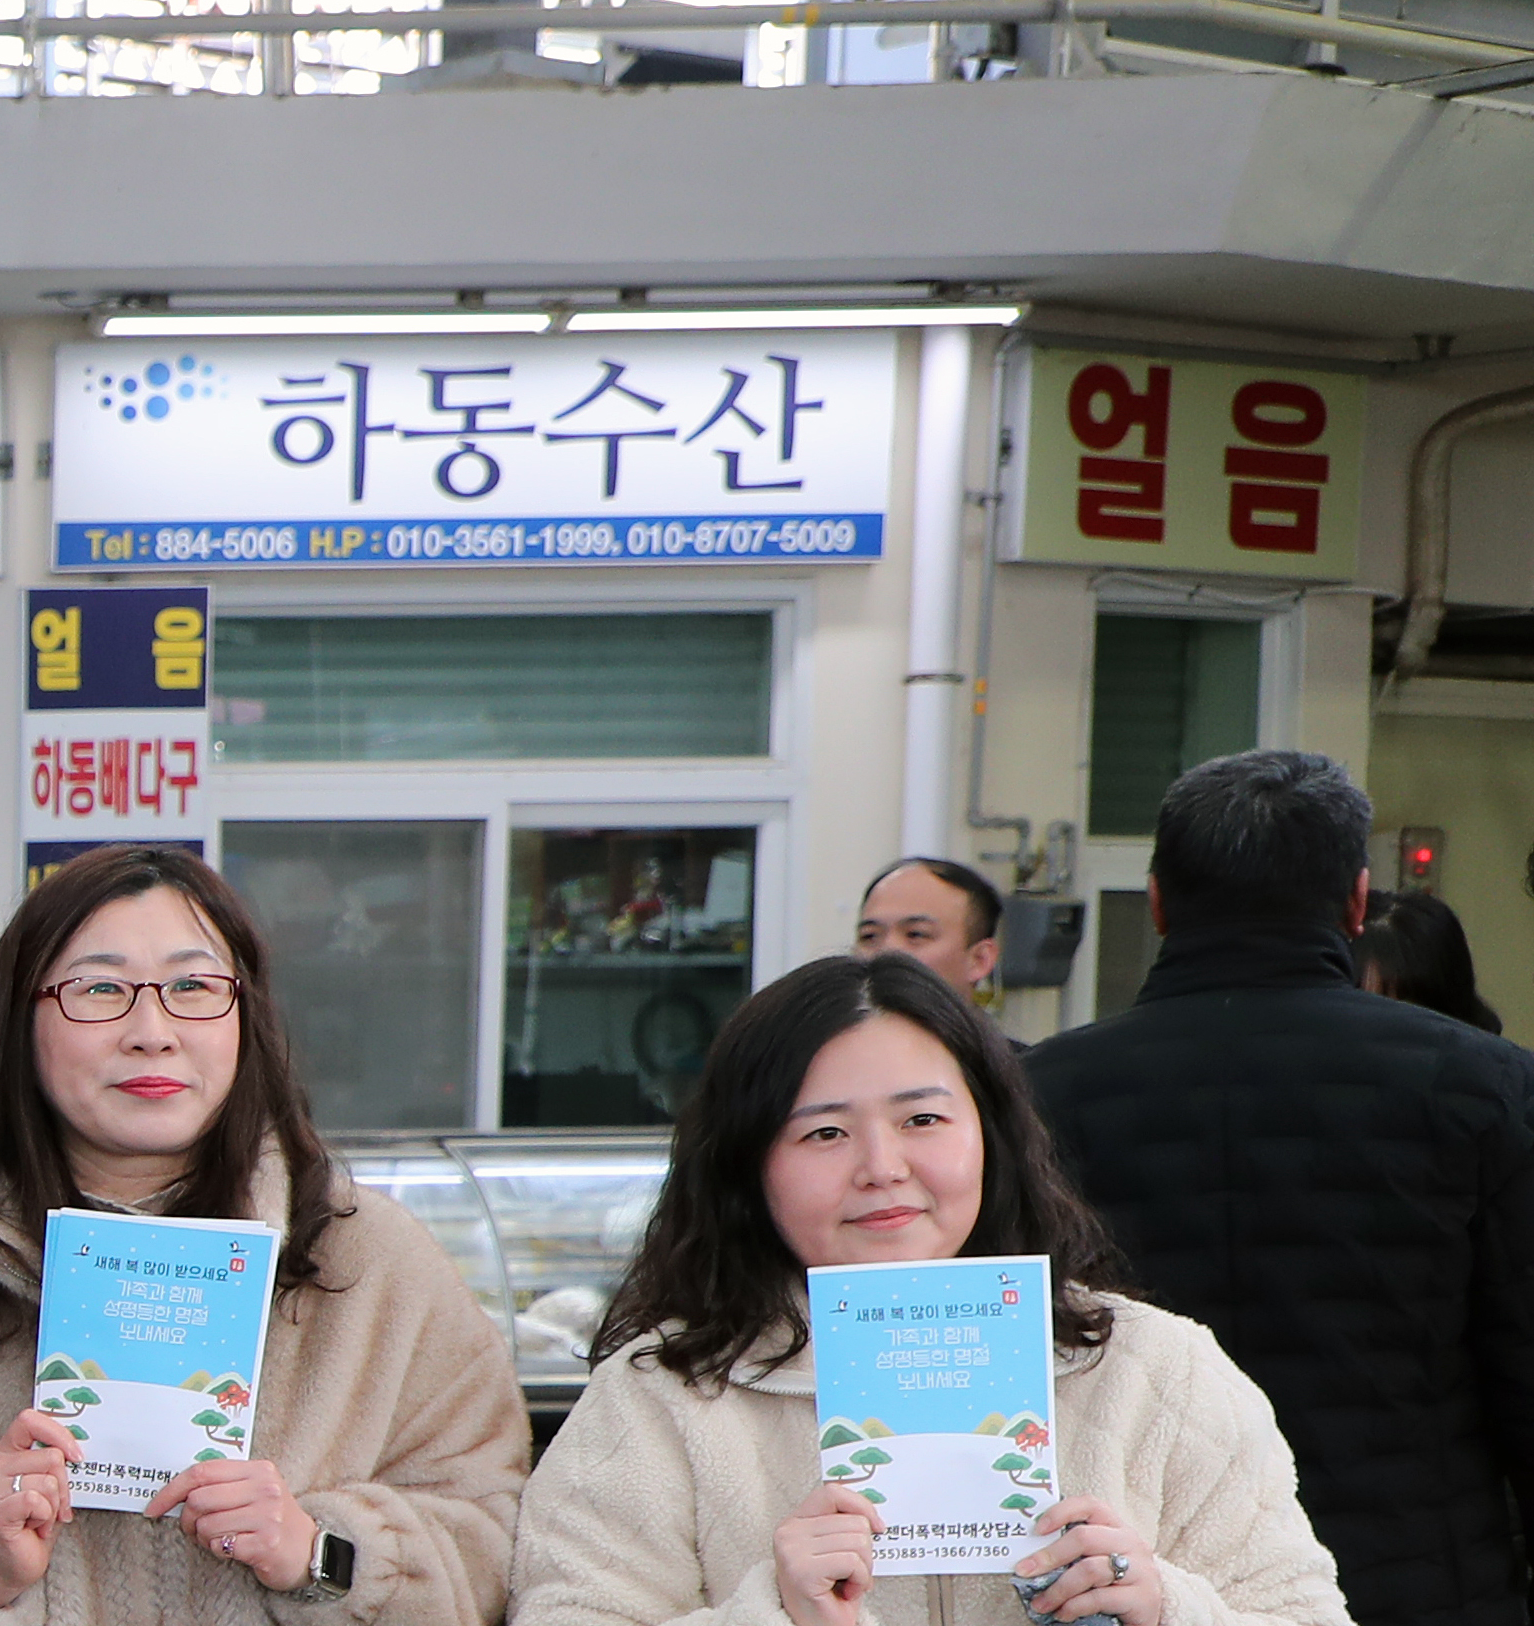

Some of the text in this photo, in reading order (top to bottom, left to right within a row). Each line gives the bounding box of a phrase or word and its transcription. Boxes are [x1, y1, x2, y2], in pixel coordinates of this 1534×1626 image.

[258, 352, 825, 503] 하동수산
[1068, 361, 1330, 556] 얼음
[155, 527, 297, 561] 884-5006
[627, 519, 856, 555] 010-8707-5009
[31, 606, 206, 692] 얼음
[34, 737, 199, 817] 하동배다구
[94, 1256, 229, 1282] 새해 복 많이 받으세요
[116, 1279, 203, 1303] 가족과 함께
[104, 1300, 208, 1326] 성평등한 명절
[855, 1303, 1003, 1322] 새해 복 많이 받으세요
[119, 1322, 186, 1344] 보내세요
[883, 1326, 980, 1346] 가족과 함께
[876, 1348, 990, 1369] 성평등한 명절
[898, 1370, 971, 1390] 보내세요
